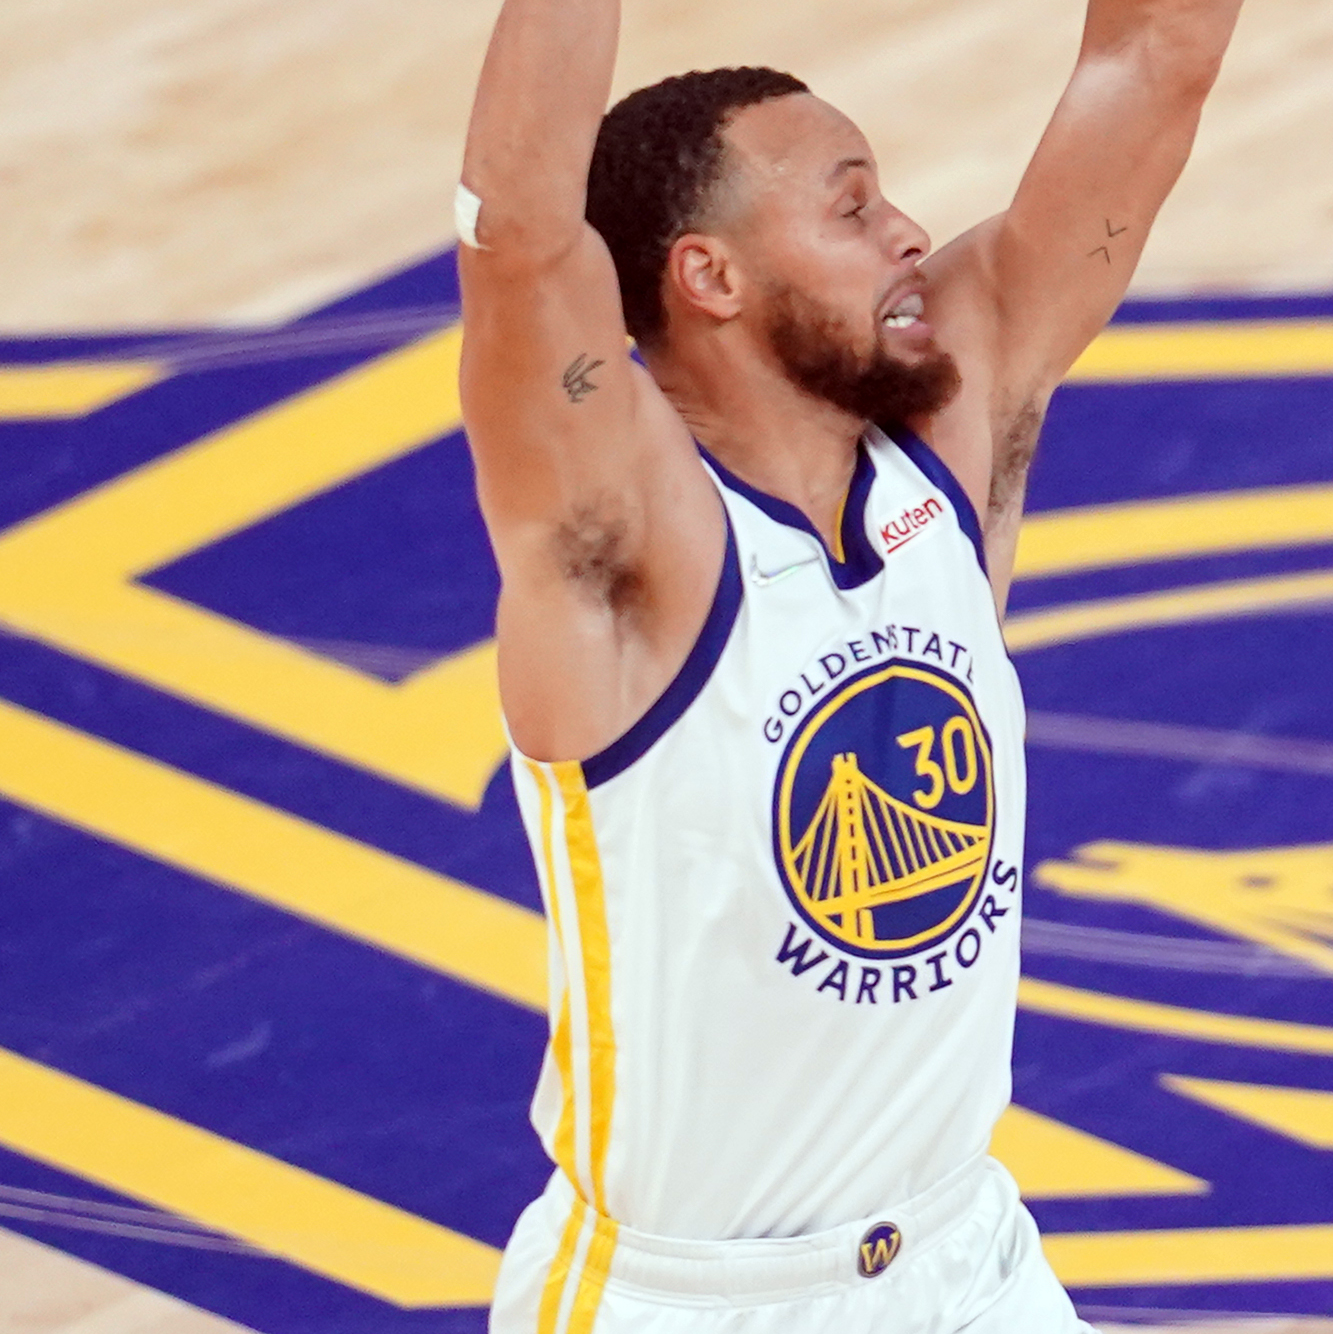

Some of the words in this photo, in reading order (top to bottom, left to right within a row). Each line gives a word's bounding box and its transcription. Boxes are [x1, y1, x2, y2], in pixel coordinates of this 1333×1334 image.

[896, 715, 978, 810] 30
[775, 858, 1018, 1005] WARRIORS
[860, 1231, 900, 1272] W
